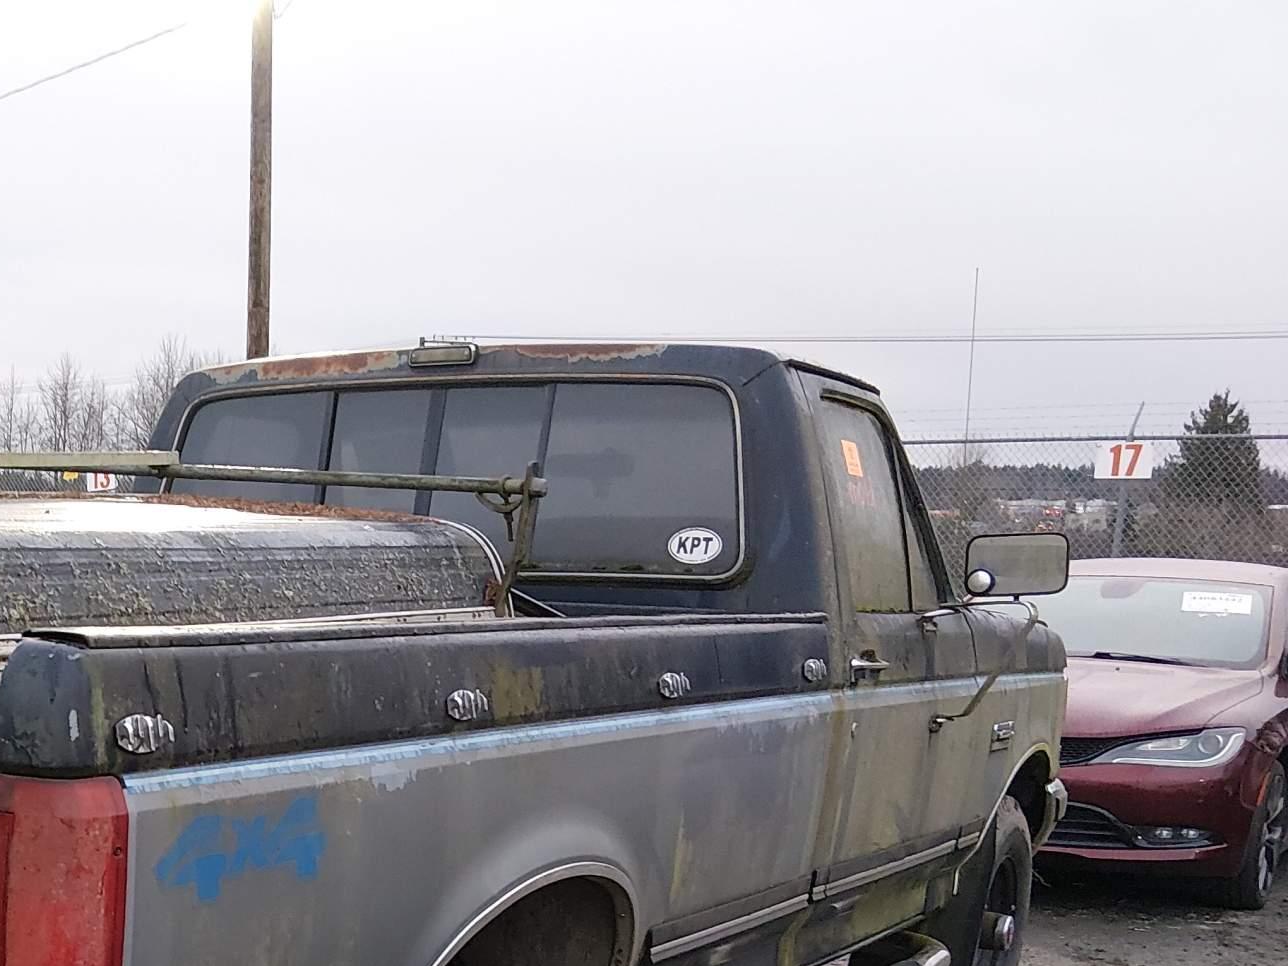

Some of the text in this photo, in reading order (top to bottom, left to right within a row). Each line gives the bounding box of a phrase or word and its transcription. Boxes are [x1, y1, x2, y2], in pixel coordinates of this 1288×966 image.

[1110, 444, 1143, 476] 17
[94, 473, 111, 489] 13
[677, 537, 713, 554] KPT
